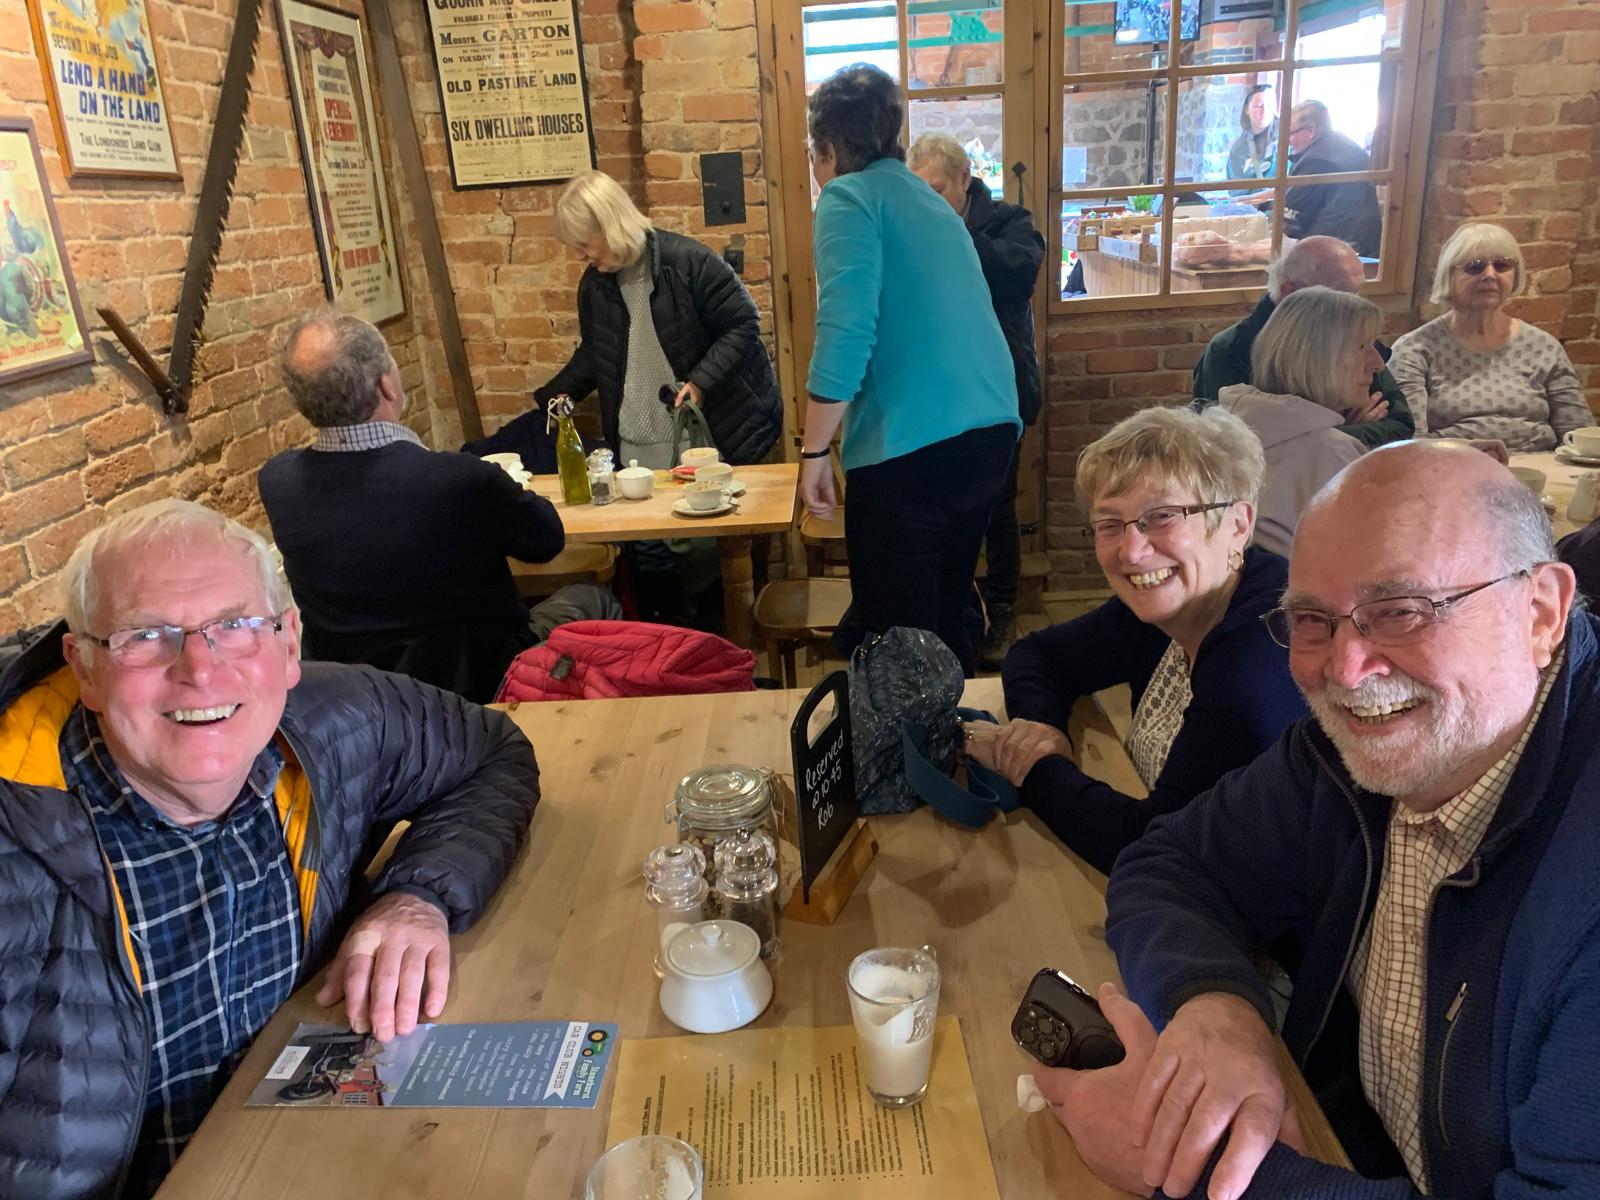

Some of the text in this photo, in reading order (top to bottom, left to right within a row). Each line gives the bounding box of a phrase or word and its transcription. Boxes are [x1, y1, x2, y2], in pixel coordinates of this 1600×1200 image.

[52, 33, 82, 52] SECOND
[482, 24, 570, 42] GARTON
[60, 59, 146, 96] LEND A HAND
[447, 73, 577, 93] OLD PASTURE LAND
[79, 90, 98, 115] ON
[102, 94, 124, 119] THE
[130, 98, 160, 124] LAND
[451, 120, 472, 141] SIX
[475, 116, 534, 140] DWELLING
[537, 113, 584, 135] HOUSES
[805, 730, 844, 791] Reserved
[818, 803, 834, 830] Rob
[554, 1026, 582, 1088] CAR CLUB NIGHTS
[573, 1060, 592, 1096] Family Farm
[582, 1066, 600, 1099] Stonehurst
